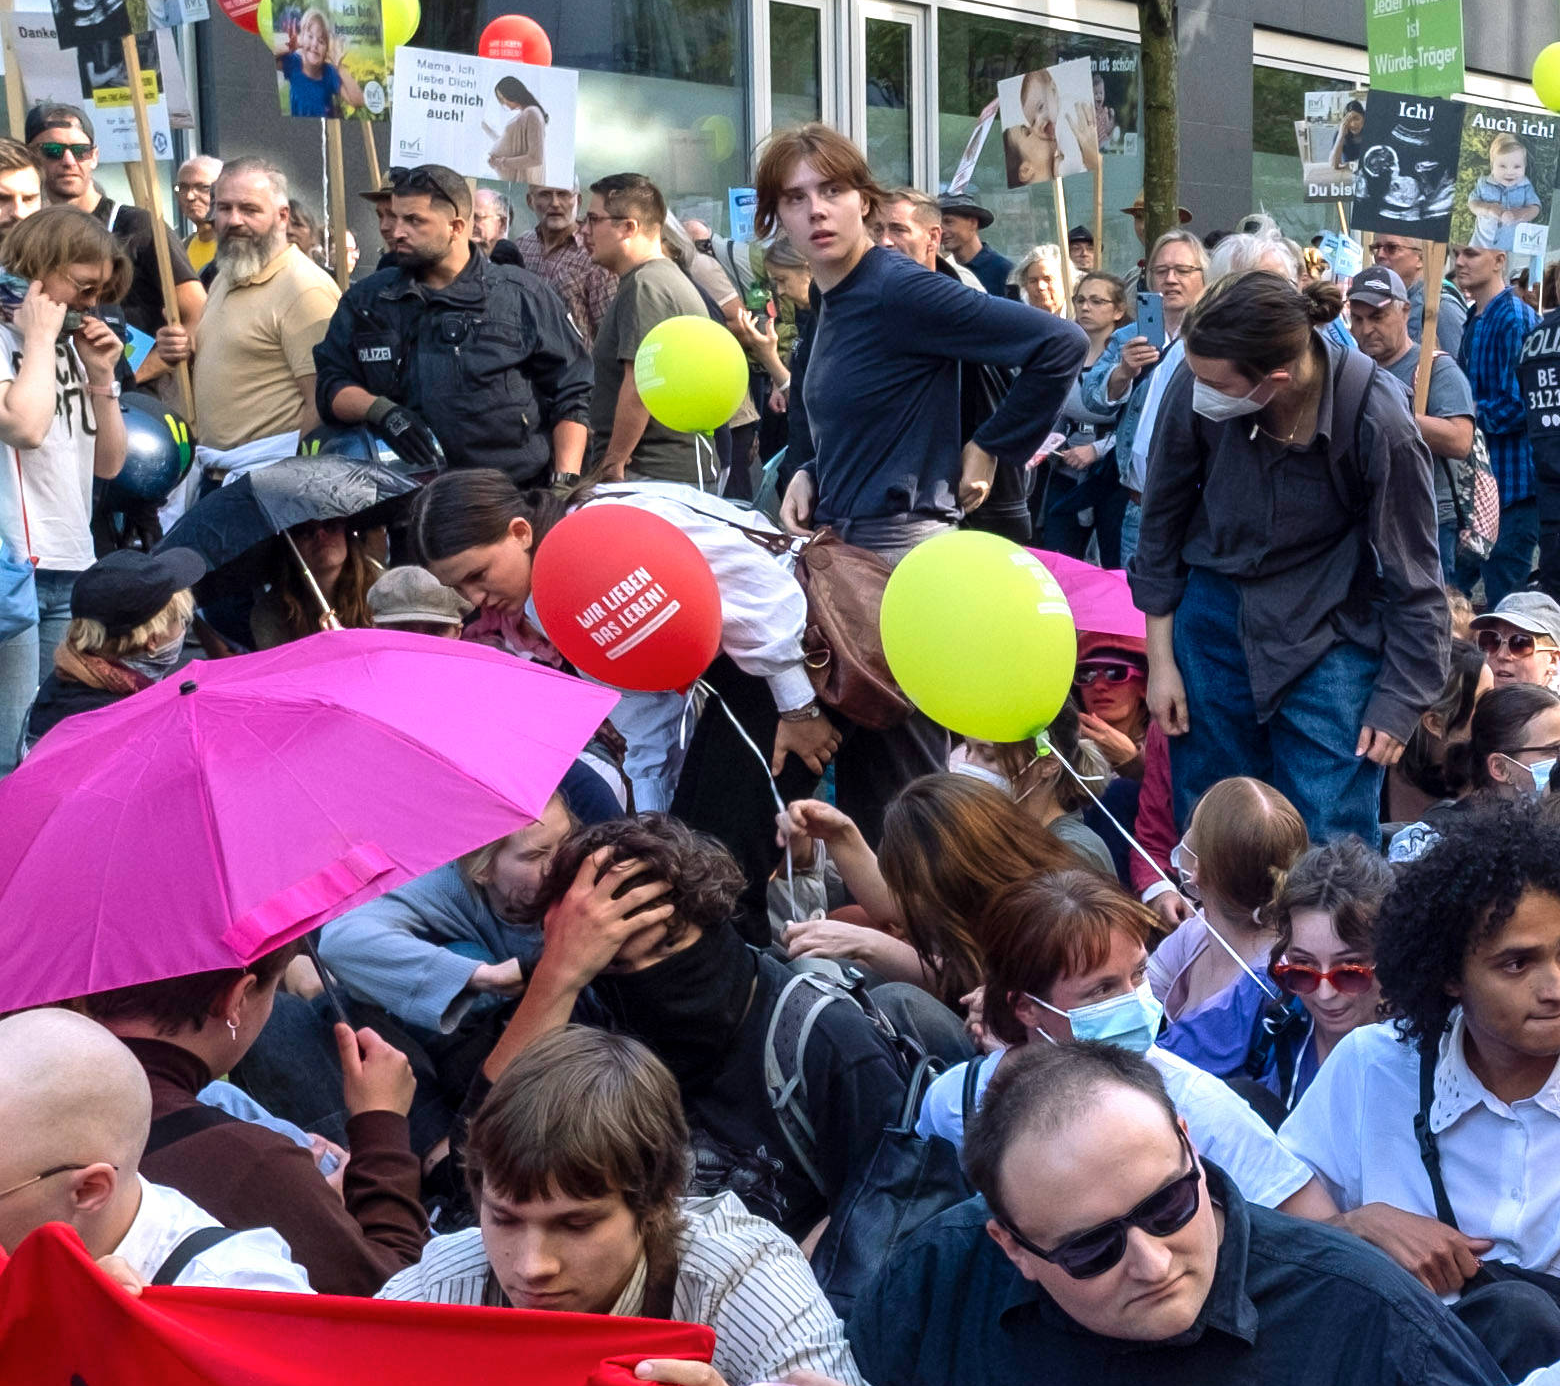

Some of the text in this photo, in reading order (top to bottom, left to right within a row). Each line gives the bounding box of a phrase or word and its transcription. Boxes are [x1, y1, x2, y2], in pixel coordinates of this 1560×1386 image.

[1406, 17, 1420, 38] ist
[416, 59, 454, 76] Mama,
[1374, 46, 1458, 76] Würde-Träger
[417, 72, 477, 89] liebe Dich!
[409, 86, 484, 108] Liebe mich
[426, 106, 464, 123] auch!
[1399, 101, 1555, 139] Ich! Auch ich!
[1308, 183, 1329, 197] Du
[1537, 368, 1558, 388] BE
[575, 566, 653, 629] WIR LIEBEN
[590, 620, 622, 647] DAS
[618, 583, 669, 629] LEBEN!
